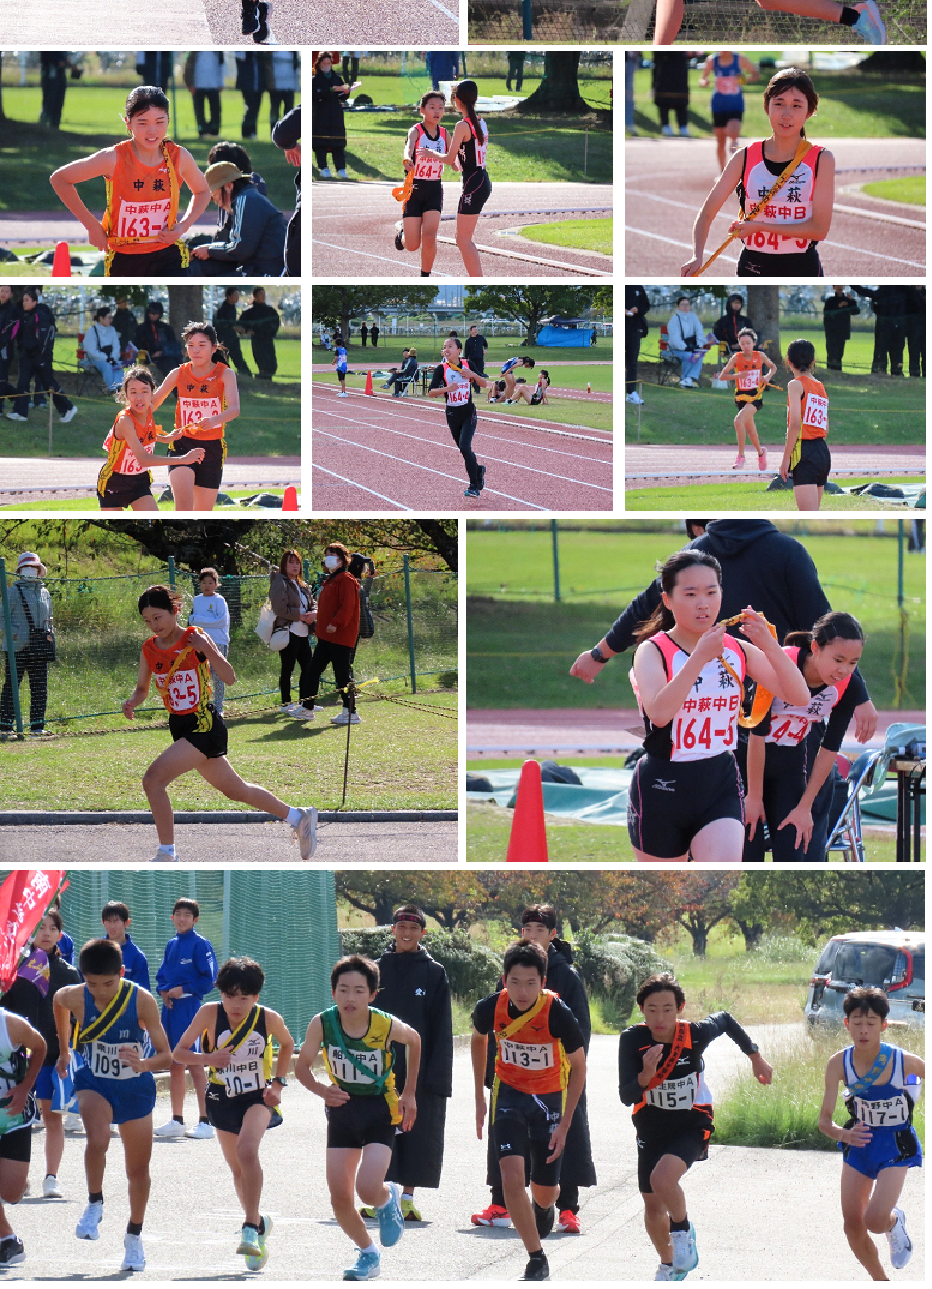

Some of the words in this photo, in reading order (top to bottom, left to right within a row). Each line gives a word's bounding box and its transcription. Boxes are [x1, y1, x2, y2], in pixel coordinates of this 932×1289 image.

[133, 179, 165, 191] 中萩
[504, 1048, 549, 1067] 113-1
[861, 1107, 905, 1125] 117-1
